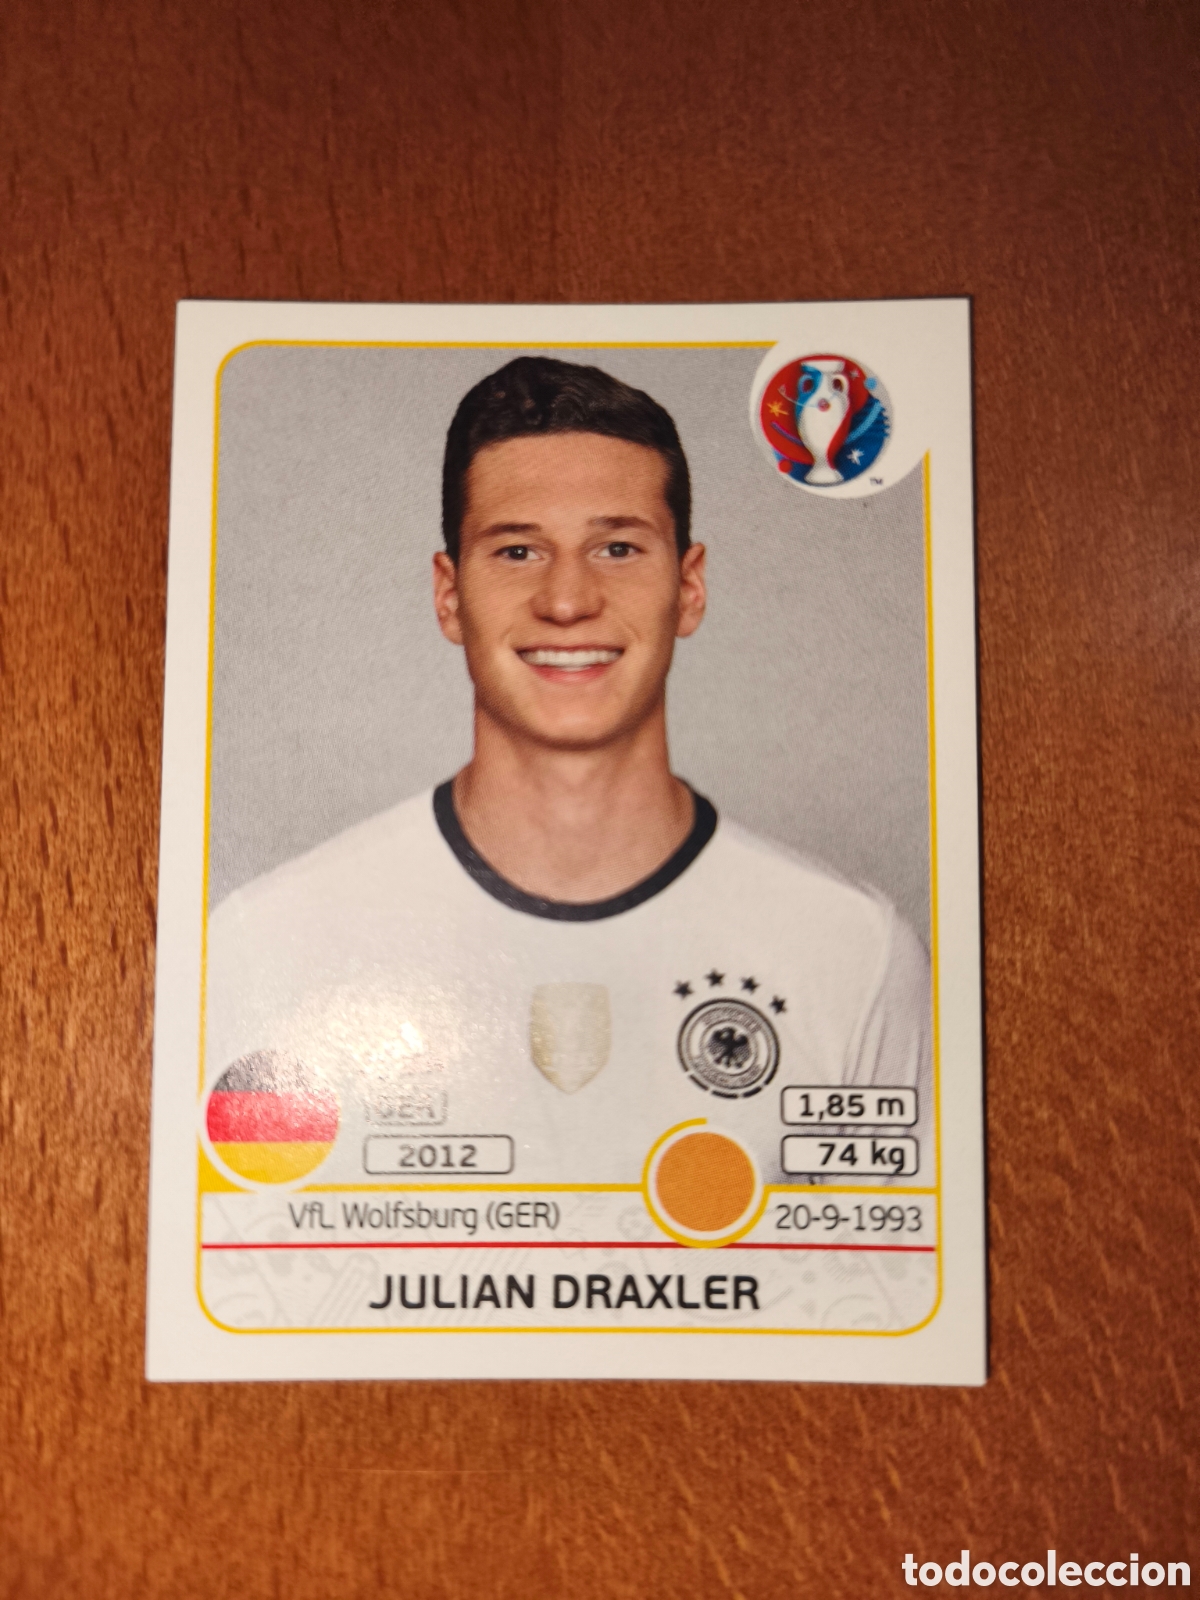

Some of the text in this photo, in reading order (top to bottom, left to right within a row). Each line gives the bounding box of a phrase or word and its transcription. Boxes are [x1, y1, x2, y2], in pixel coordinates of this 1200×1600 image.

[798, 1093, 905, 1121] 1,85 m
[398, 1144, 478, 1168] 2012
[818, 1141, 906, 1174] 74 kg
[288, 1201, 562, 1236] VfL Wolfsburg (GER)
[775, 1204, 924, 1232] 20-9-1993
[369, 1273, 761, 1310] JULIAN DRAXLER
